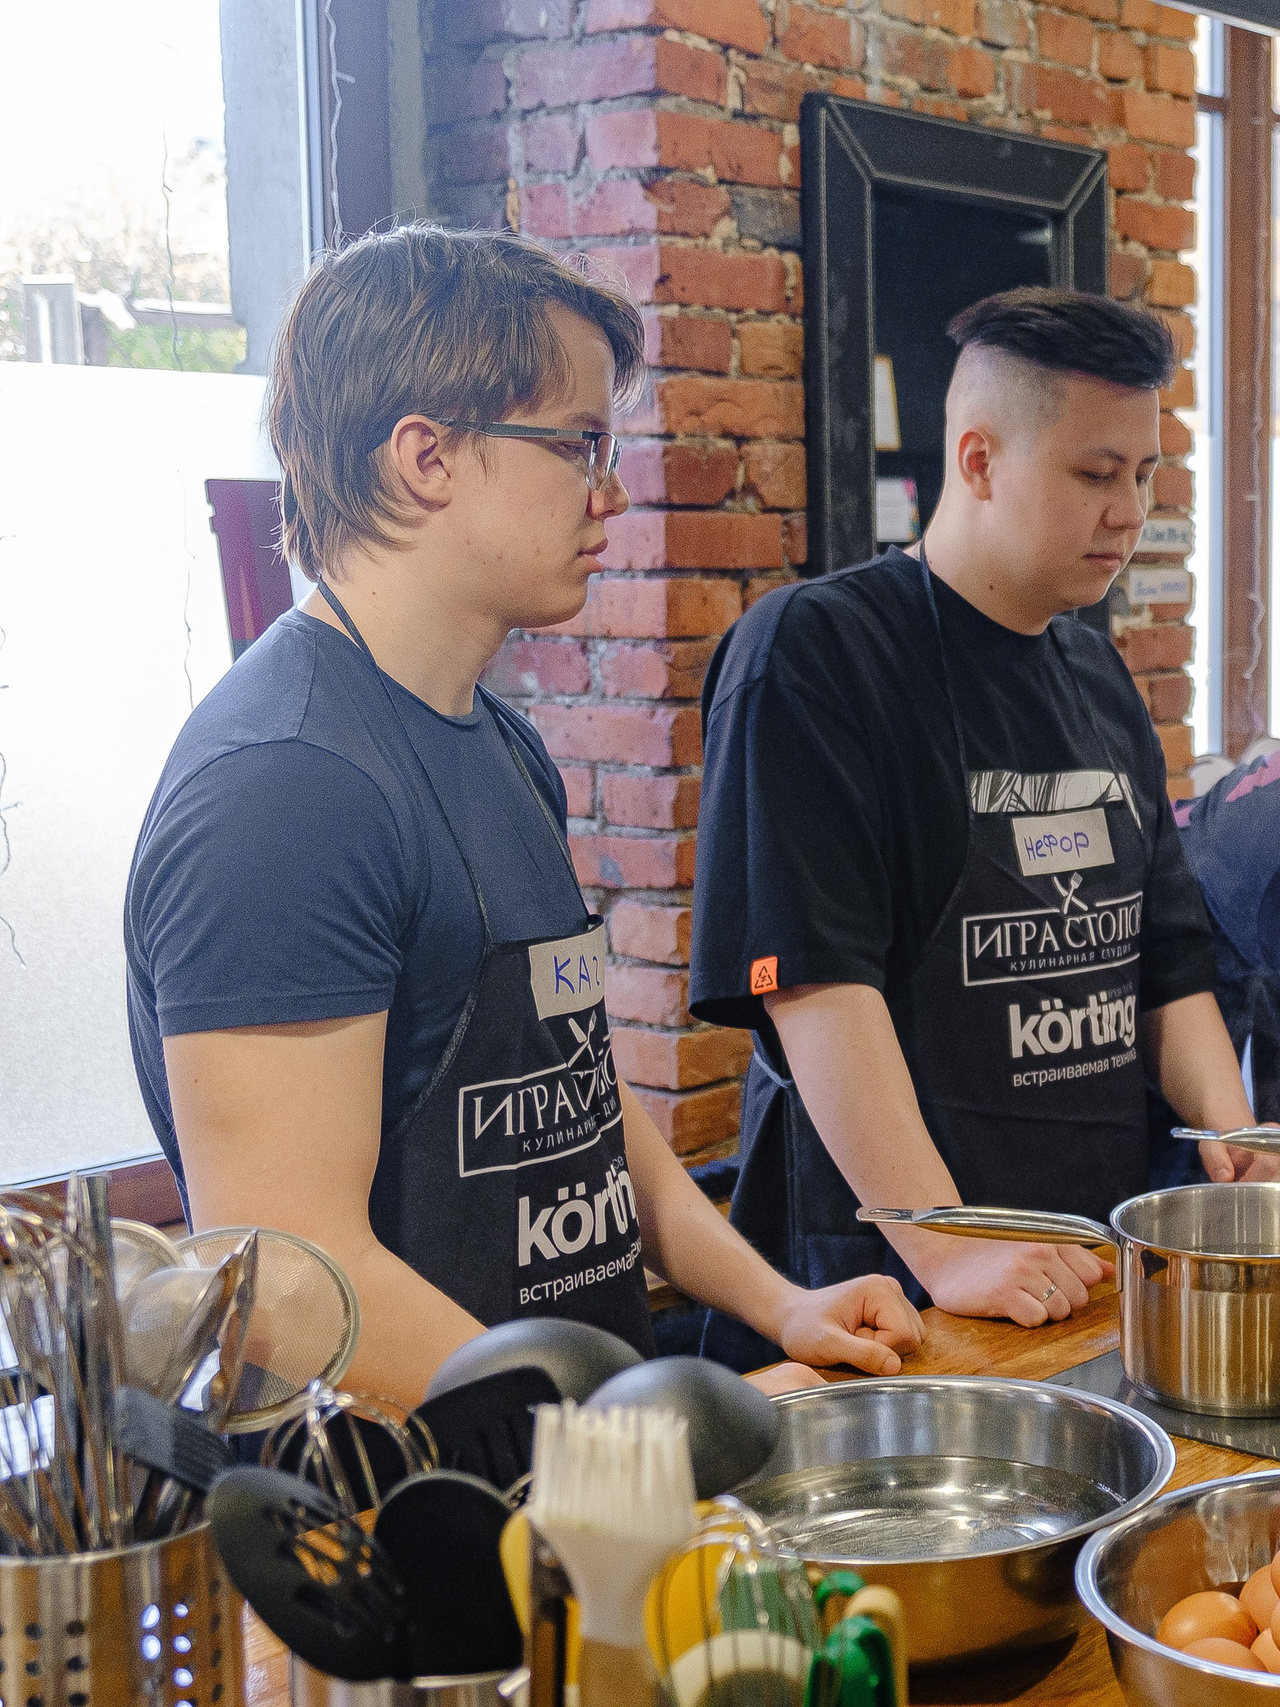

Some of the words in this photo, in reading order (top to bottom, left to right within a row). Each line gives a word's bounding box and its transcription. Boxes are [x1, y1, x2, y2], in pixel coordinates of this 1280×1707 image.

[973, 919, 1060, 959] ИГРА
[1010, 951, 1096, 972] КУЛИНАРНАЯ
[1009, 990, 1137, 1059] körting
[1013, 1058, 1110, 1088] встраиваемая
[474, 1078, 578, 1140] ИГРА
[518, 1163, 641, 1268] körtin
